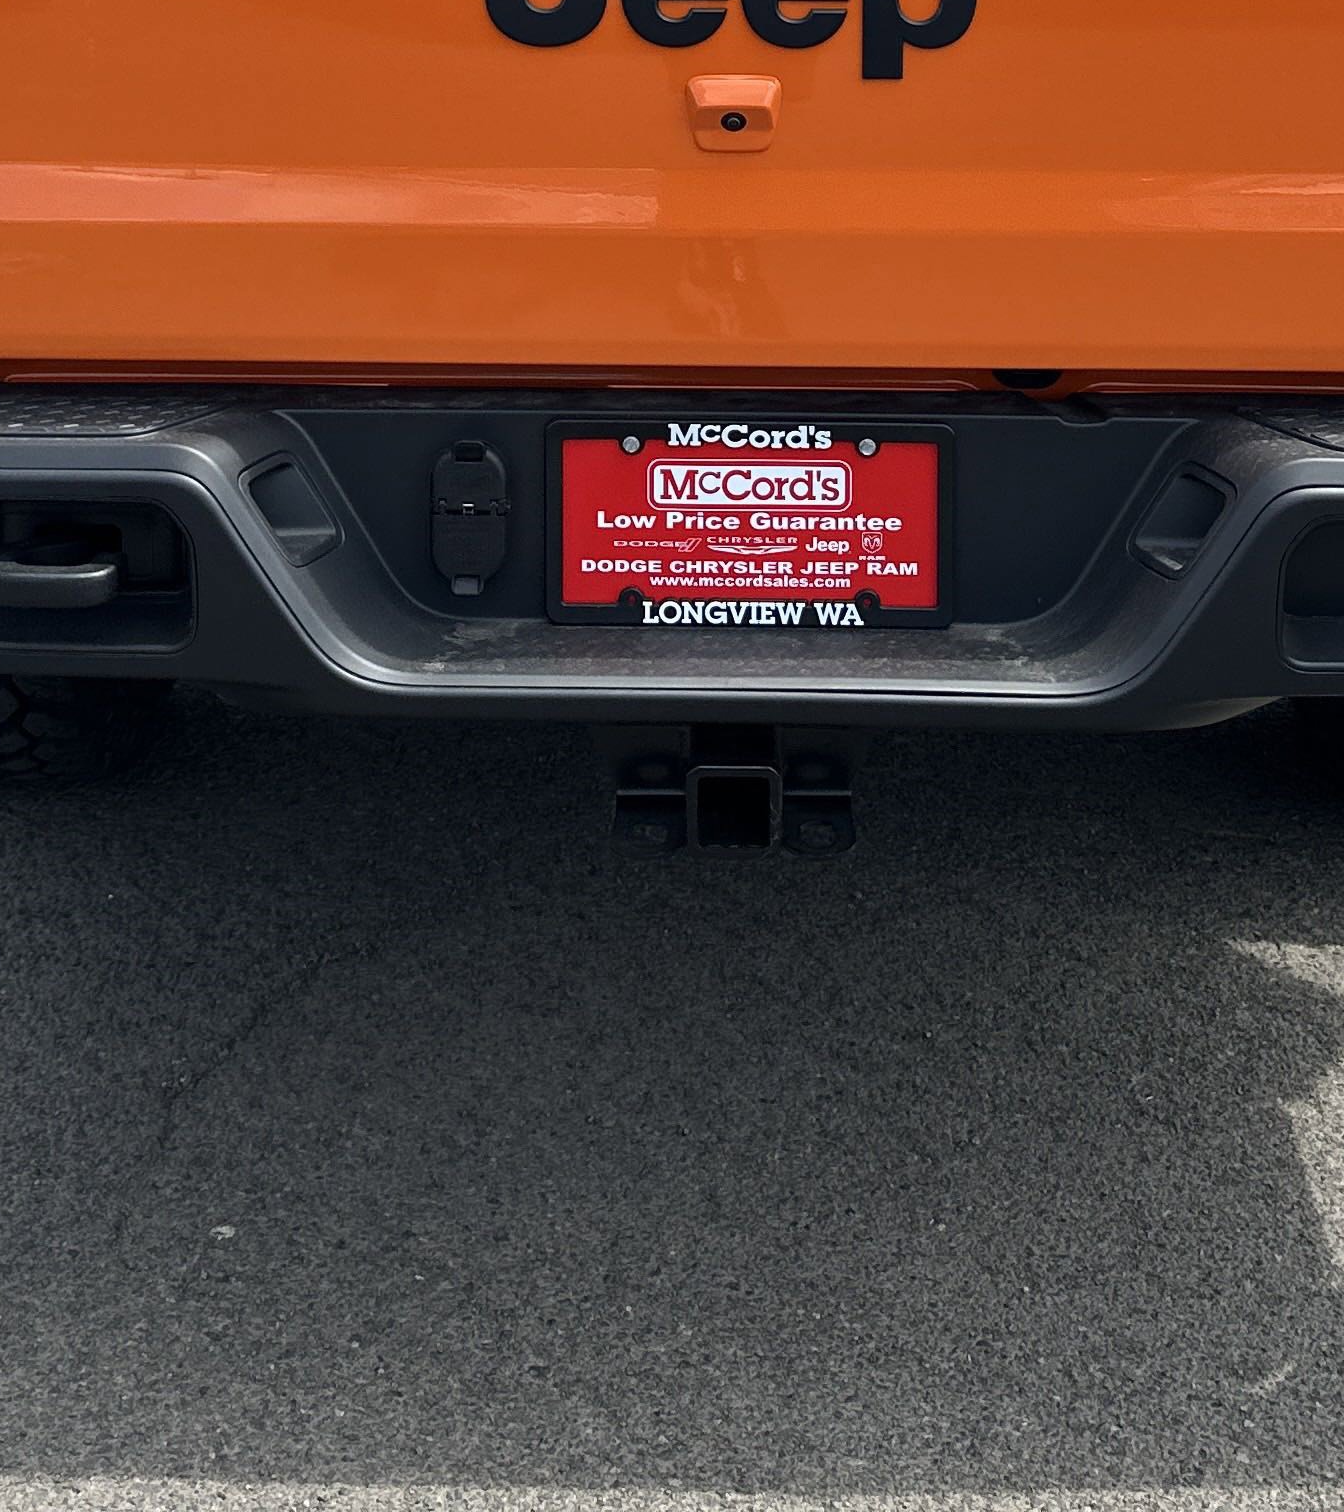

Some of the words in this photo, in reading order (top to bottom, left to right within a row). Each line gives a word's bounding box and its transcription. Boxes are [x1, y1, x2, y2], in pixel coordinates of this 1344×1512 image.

[668, 423, 832, 450] McCord's
[659, 468, 840, 501] McCord's
[597, 510, 656, 529] Low
[666, 511, 740, 530] Price
[750, 512, 902, 531] Guarantee
[706, 536, 798, 544] CHRYSLER
[805, 536, 850, 555] Jeep
[581, 559, 662, 573] DODGE
[669, 560, 793, 575] CHRYSLER
[800, 561, 859, 575] JEEP
[866, 562, 918, 576] RAM
[649, 574, 851, 588] www.mccordsales.com
[642, 600, 806, 625] LONGVIEW
[814, 602, 864, 626] WA
